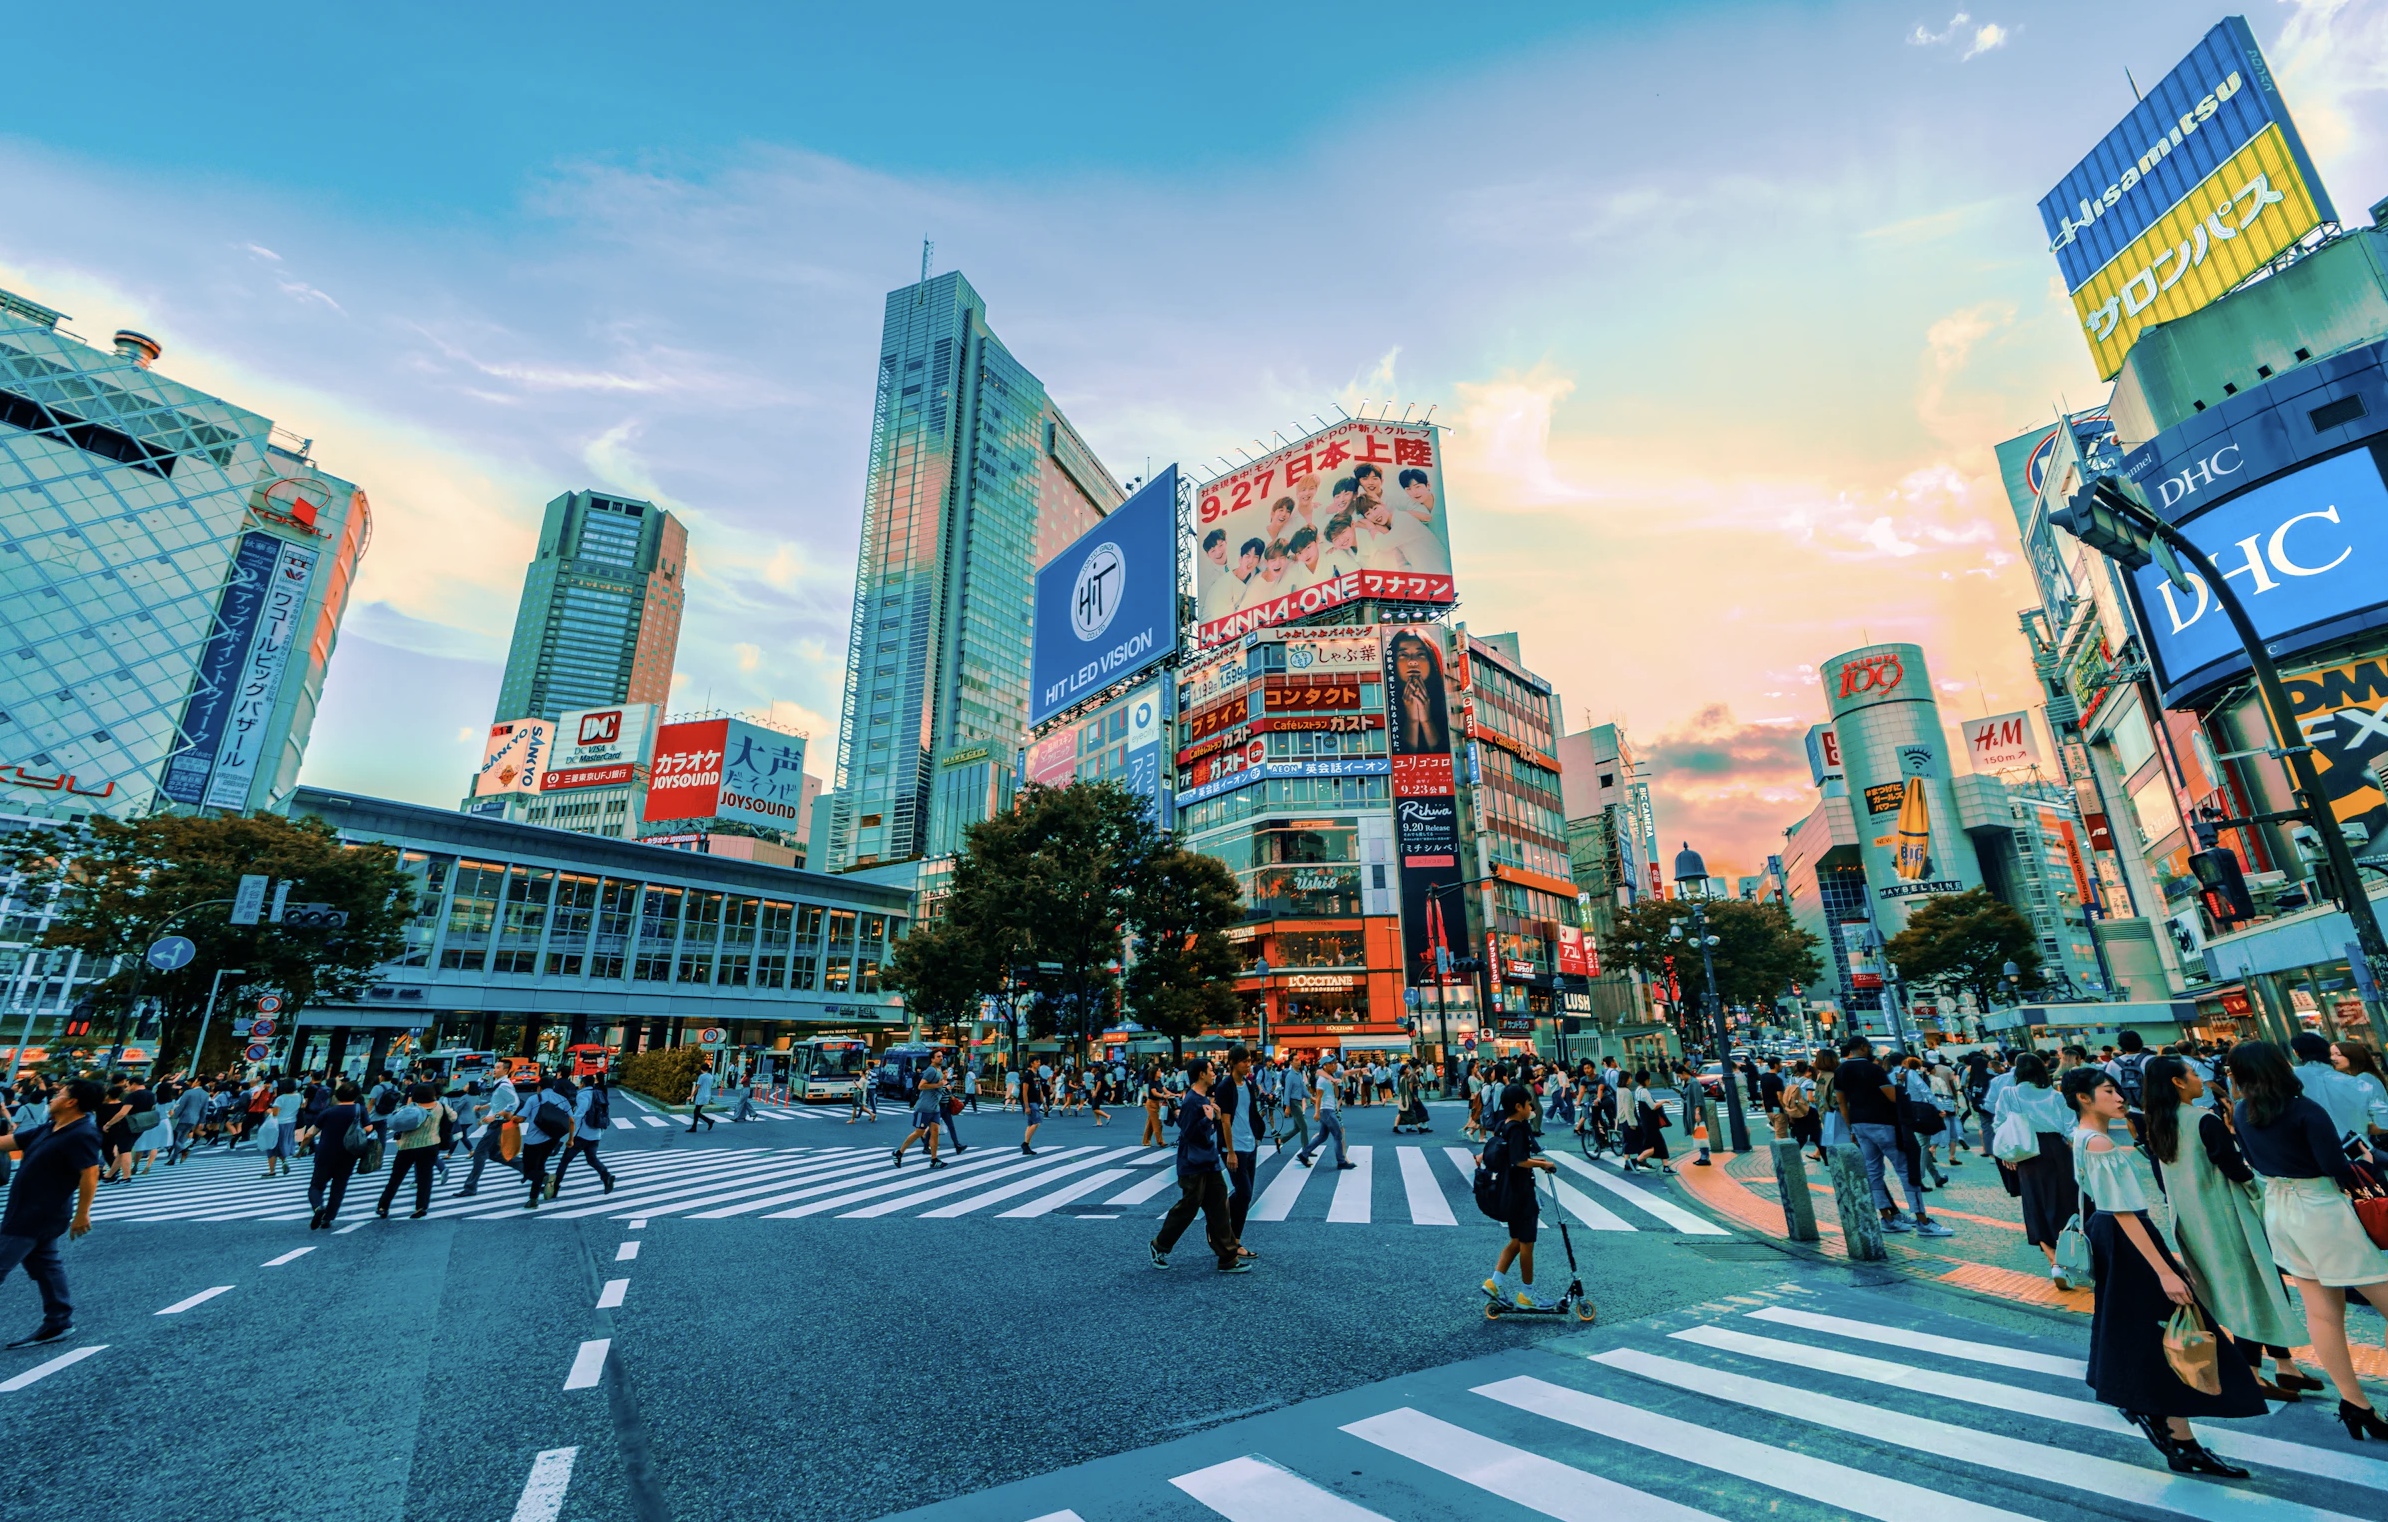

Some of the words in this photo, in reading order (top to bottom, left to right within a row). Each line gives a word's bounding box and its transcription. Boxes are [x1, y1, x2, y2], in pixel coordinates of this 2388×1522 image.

[2049, 71, 2243, 253] Hisamitsu
[2086, 172, 2284, 342] サロンパス
[1200, 470, 1275, 524] 9.27
[1286, 435, 1433, 488] 日本上陸
[2157, 443, 2244, 509] DHC
[2156, 505, 2352, 636] DHC
[1364, 574, 1449, 595] ワナワン
[1275, 626, 1373, 639] しゃぶしゃぶバイキング
[1318, 644, 1376, 663] しゃぶ葉
[1045, 677, 1069, 707] HIT
[1070, 661, 1098, 691] LED
[1100, 628, 1152, 668] VISION
[222, 591, 292, 767] ワコールビッグバザール
[1837, 661, 1904, 698] 109
[1180, 690, 1190, 703] 9F
[1265, 687, 1357, 706] コンタクト
[581, 715, 617, 741] DC
[1192, 700, 1247, 737] プライス
[1330, 716, 1374, 732] ガスト
[1223, 727, 1251, 749] ガスト
[1974, 718, 2022, 751] H&M
[482, 728, 528, 773] SANKYO
[522, 726, 546, 787] SANKYO
[566, 756, 579, 764] DC
[579, 751, 622, 763] MasterCard
[574, 747, 587, 755] DC
[588, 745, 606, 754] VISA
[727, 736, 802, 776] 大声
[655, 750, 721, 774] カラオケ
[1210, 753, 1244, 781] ガスト
[1271, 765, 1298, 773] AEON
[1306, 762, 1388, 773] 英会話イーオン
[1394, 756, 1451, 771] ユリゴコロ
[1984, 755, 2016, 765] 150m
[564, 769, 626, 783] 三菱東京UFJ銀行
[652, 771, 719, 790] JOYSOUND
[1180, 772, 1192, 787] 7F
[1251, 769, 1260, 778] 6F
[1198, 772, 1248, 797] 英会話イーオン
[1639, 787, 1648, 801] BIC
[720, 791, 796, 819] JOYSOUND
[1398, 801, 1452, 821] Rihwa
[1875, 803, 1898, 812] パワー
[1402, 822, 1424, 832] 9.20
[1641, 804, 1654, 837] CAMERA
[1876, 837, 1892, 845] NEW
[2092, 827, 2107, 837] JTB
[1400, 843, 1458, 853] 「ミチシルベ」
[1901, 846, 1924, 860] BIG
[1563, 945, 1580, 959] アコム
[1288, 975, 1353, 987] L'OCCITANE
[1563, 993, 1591, 1011] LUSH
